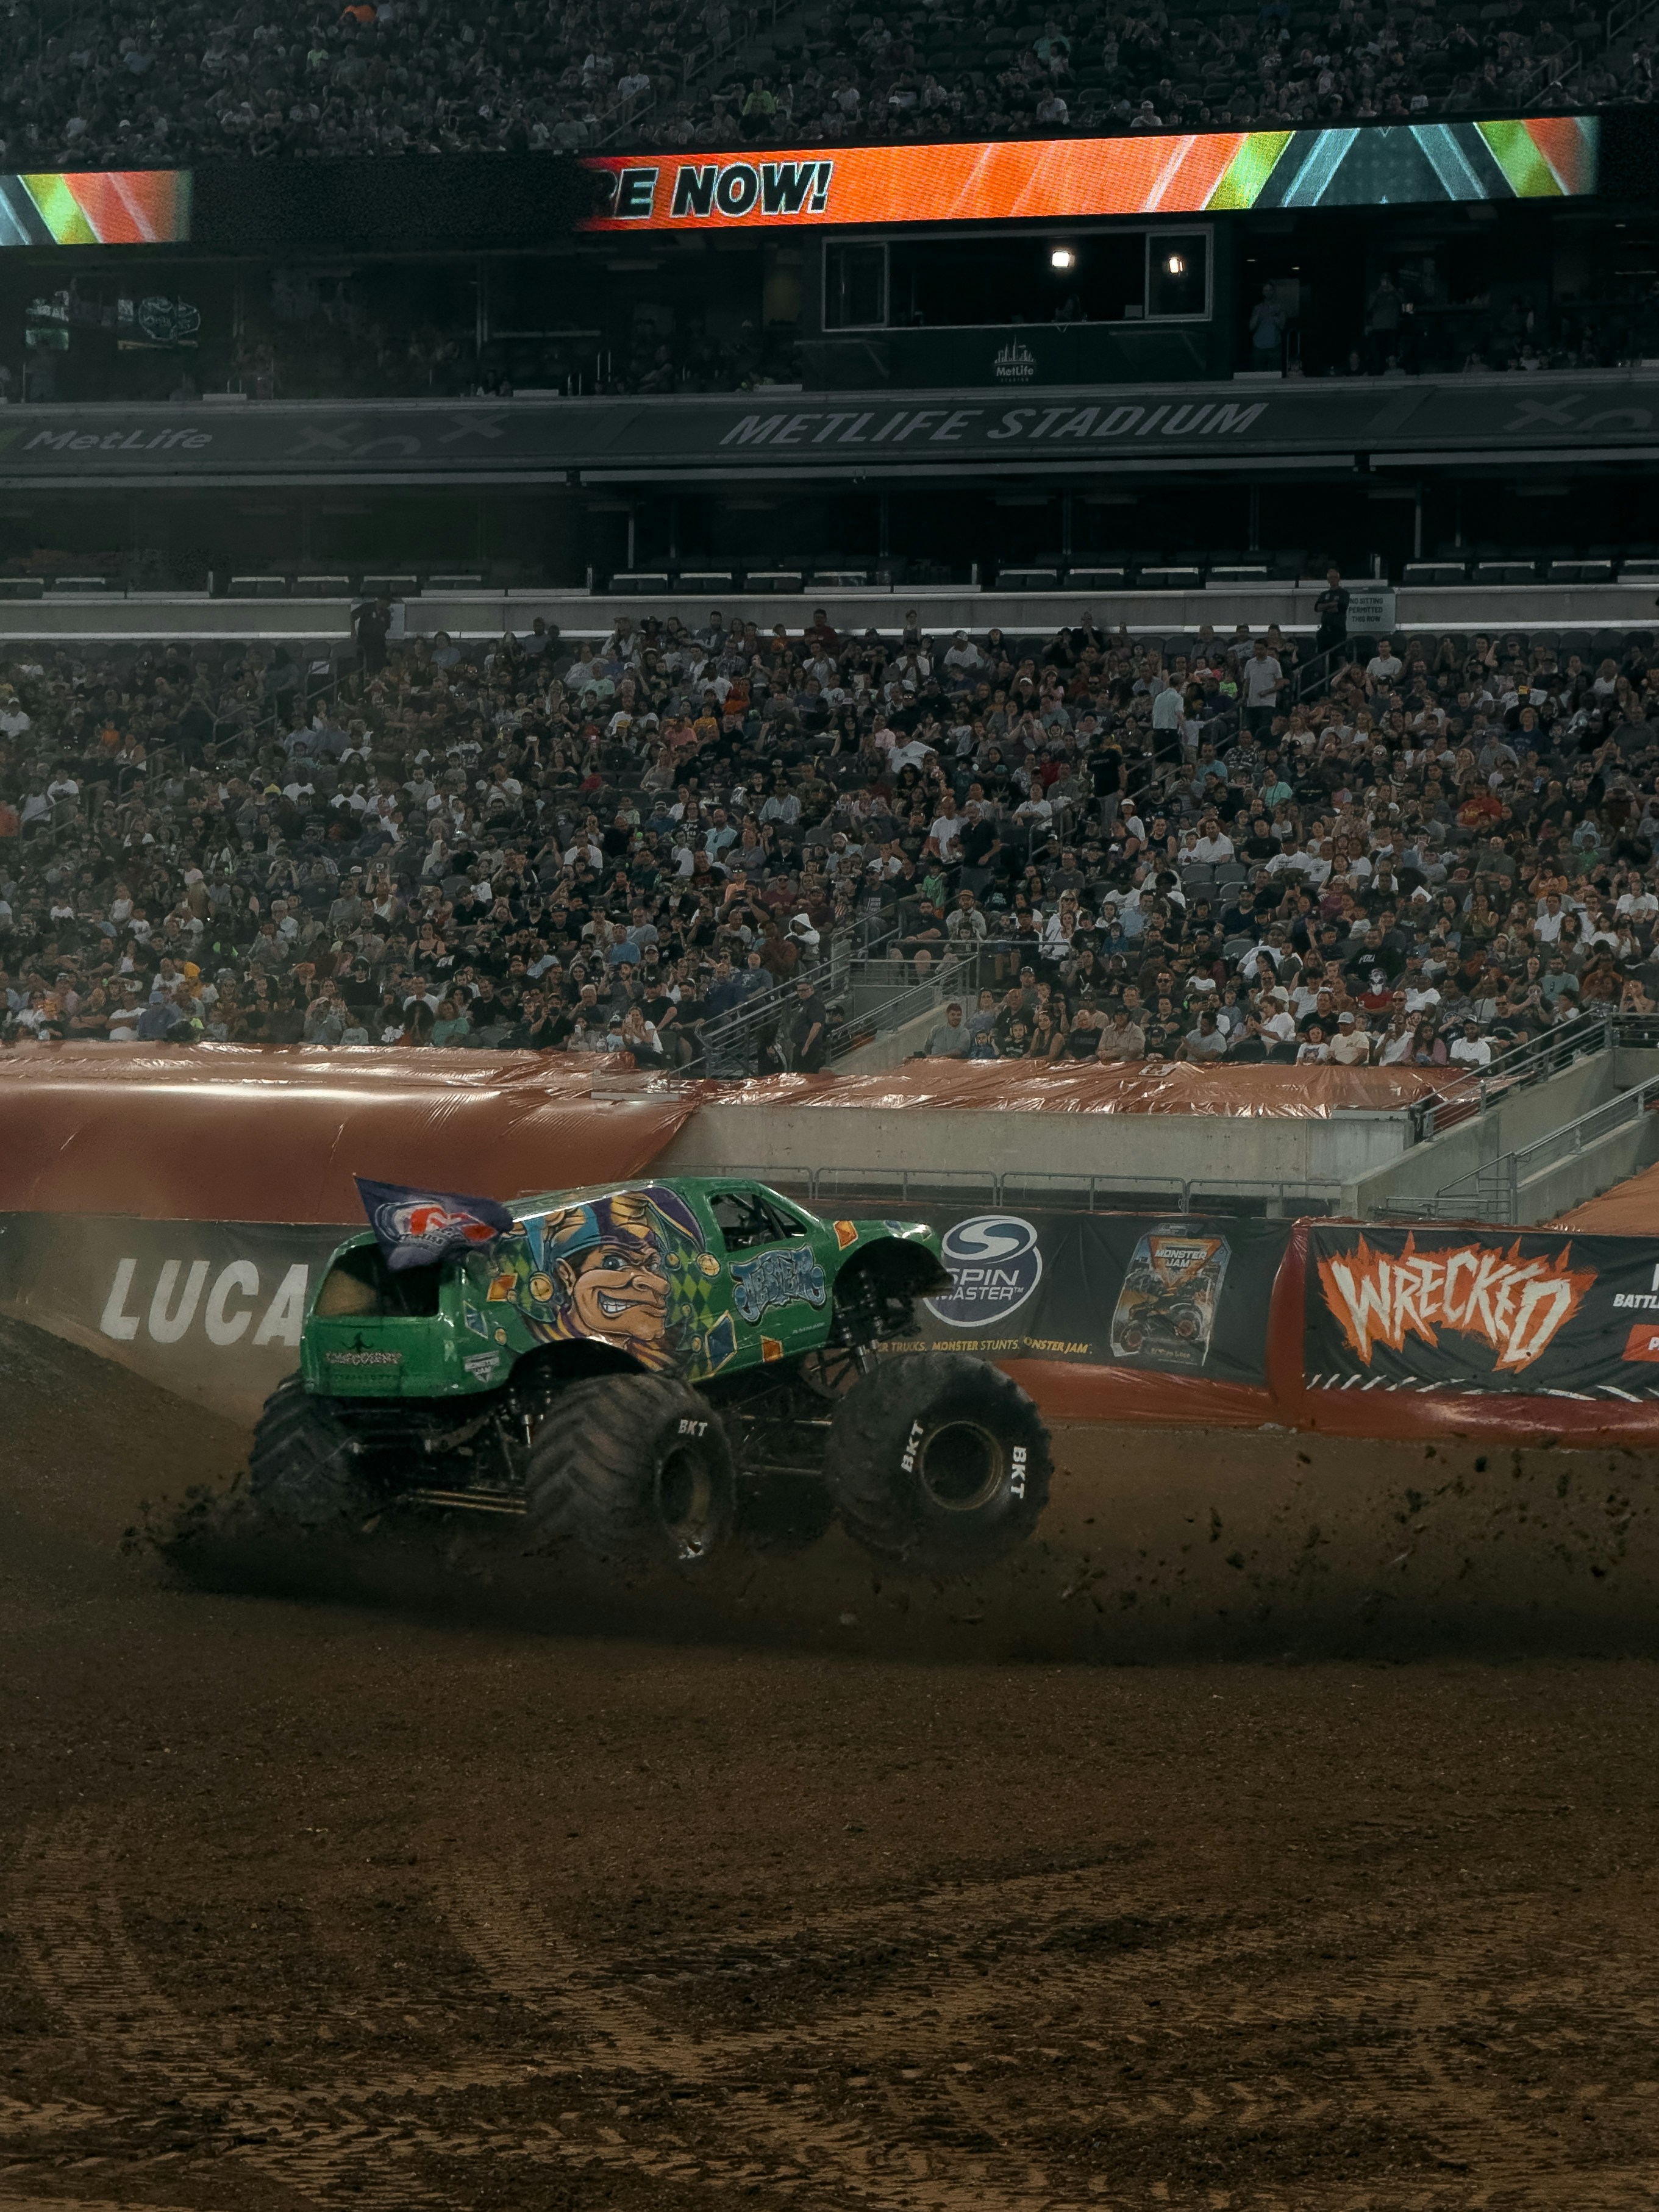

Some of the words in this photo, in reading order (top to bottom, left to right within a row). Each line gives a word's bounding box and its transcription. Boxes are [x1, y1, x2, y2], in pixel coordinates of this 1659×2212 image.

[669, 160, 833, 218] NOW!
[996, 365, 1034, 376] MetLife
[718, 410, 984, 445] METLIFE
[986, 402, 1269, 439] STADIUM
[21, 428, 213, 450] MetLife
[1155, 1249, 1207, 1260] MONSTER
[1166, 1258, 1190, 1268] JAM
[1331, 1250, 1571, 1363] WRECKED
[891, 1342, 927, 1352] TRUCKS.
[932, 1340, 979, 1351] MONSTER
[1022, 1336, 1064, 1351] ONSTER
[678, 1419, 707, 1436] BKT
[901, 1419, 923, 1472] BKT
[1011, 1446, 1027, 1499] BKT
